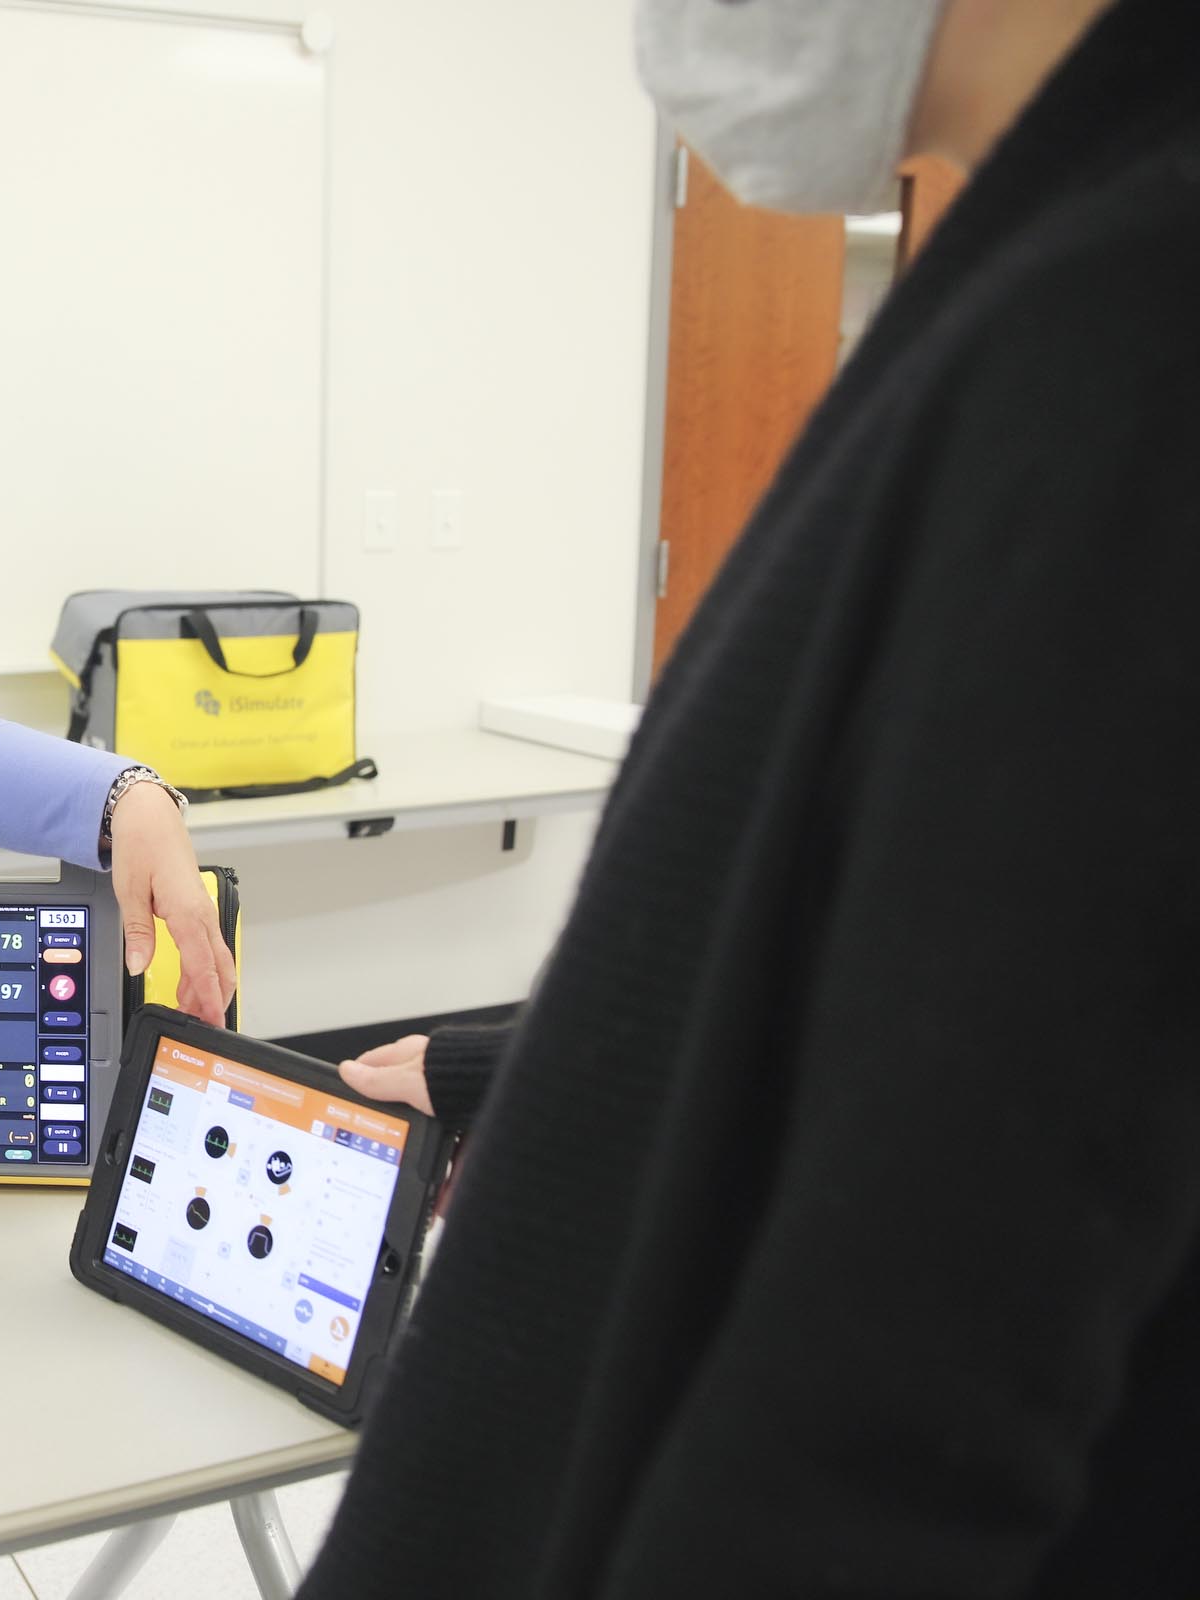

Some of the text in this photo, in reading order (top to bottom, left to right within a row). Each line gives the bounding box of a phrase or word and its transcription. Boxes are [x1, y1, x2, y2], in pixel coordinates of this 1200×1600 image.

[229, 696, 304, 713] iSimulate
[48, 913, 77, 924] 150J
[0, 933, 23, 950] 78
[0, 983, 23, 1000] 97
[24, 1073, 35, 1088] 0
[26, 1096, 35, 1108] 0
